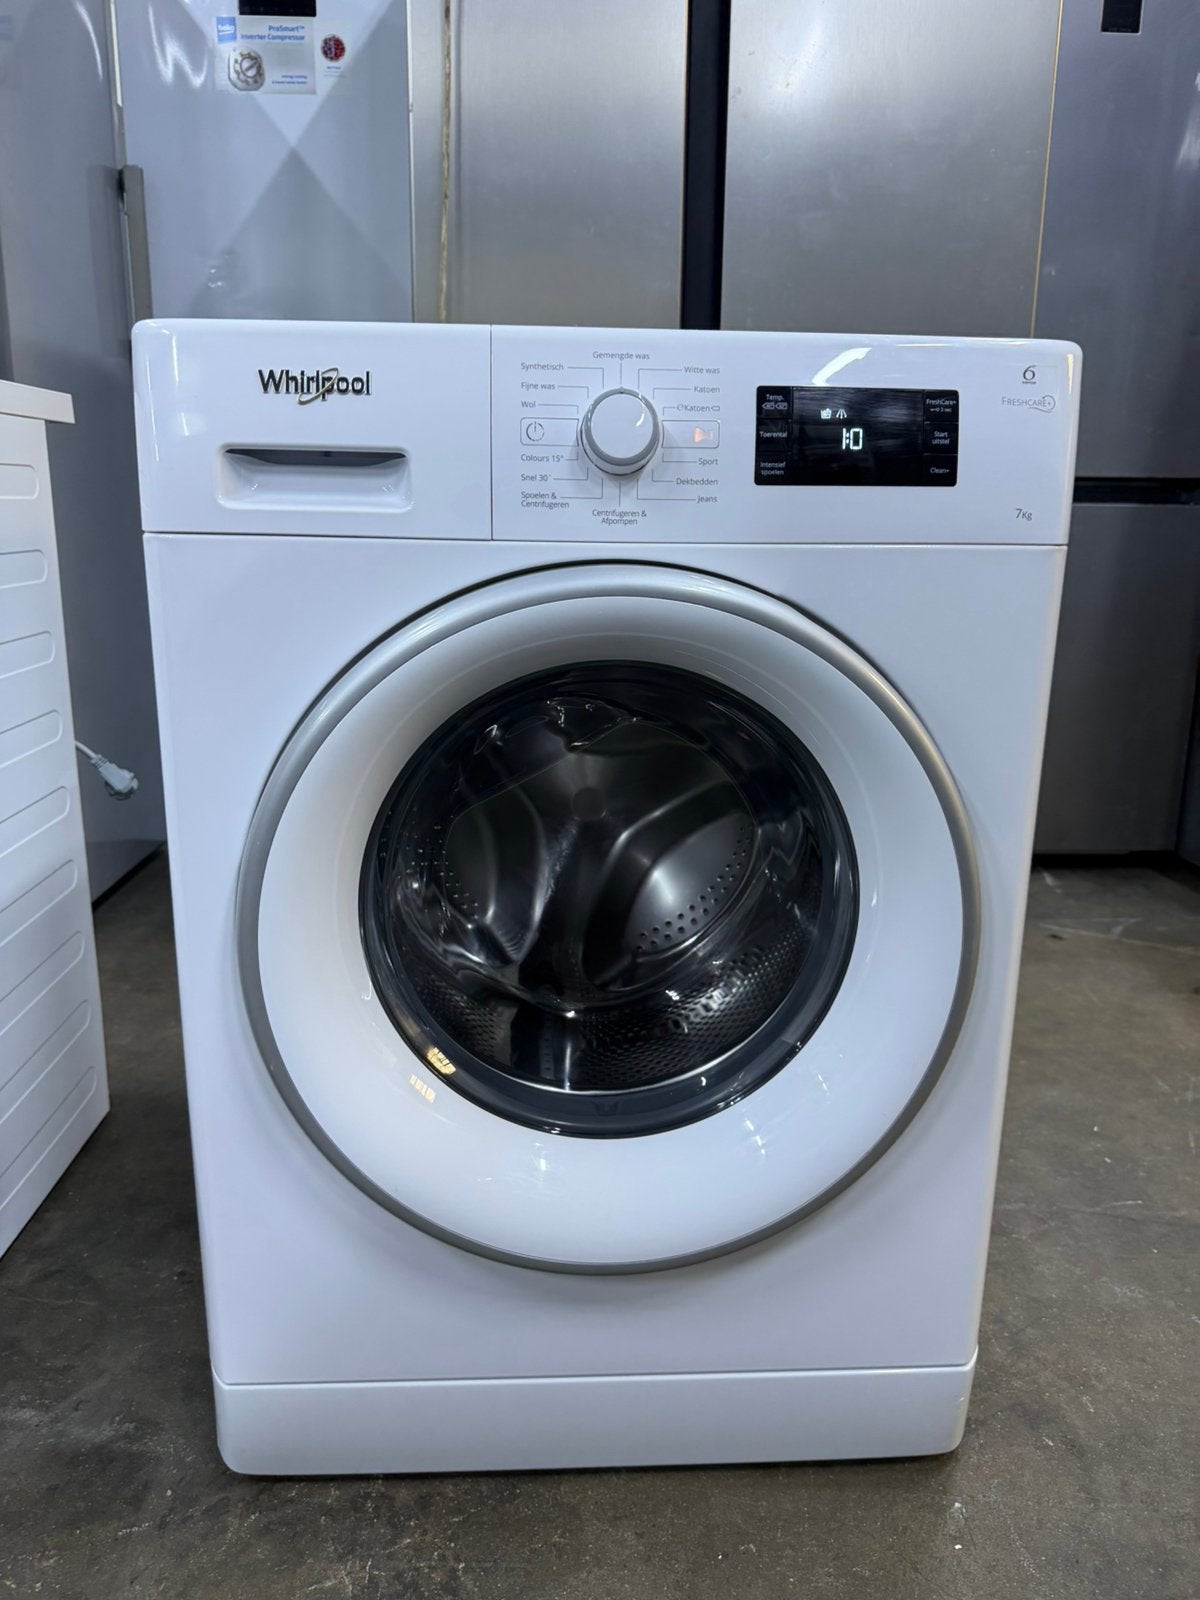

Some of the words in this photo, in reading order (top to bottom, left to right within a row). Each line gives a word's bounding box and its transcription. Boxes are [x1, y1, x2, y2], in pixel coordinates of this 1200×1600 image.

[592, 351, 634, 361] Gemengde
[520, 362, 564, 371] Synthetisch
[684, 365, 704, 374] Witte
[1022, 364, 1037, 381] 6
[257, 367, 373, 402] Whirlpool
[520, 381, 540, 391] Fijne
[693, 385, 721, 393] Katoen
[765, 394, 785, 402] Temp.
[520, 400, 536, 408] Wol
[684, 404, 711, 412] Katoen
[759, 430, 788, 439] Toerental
[934, 430, 949, 438] Start
[520, 453, 549, 463] Colours
[551, 455, 565, 463] 15°
[698, 457, 719, 467] Sport
[760, 468, 785, 476] spoelen
[930, 466, 950, 474] Clean+
[520, 473, 538, 482] Snel
[675, 477, 719, 486] Dekbedden
[520, 491, 549, 501] Spoelen
[550, 492, 558, 500] &
[697, 494, 719, 504] Jeans
[520, 500, 570, 510] Centrifugeren
[591, 508, 640, 518] Centrifugeren
[641, 510, 648, 518] &
[600, 517, 638, 526] Afpompen
